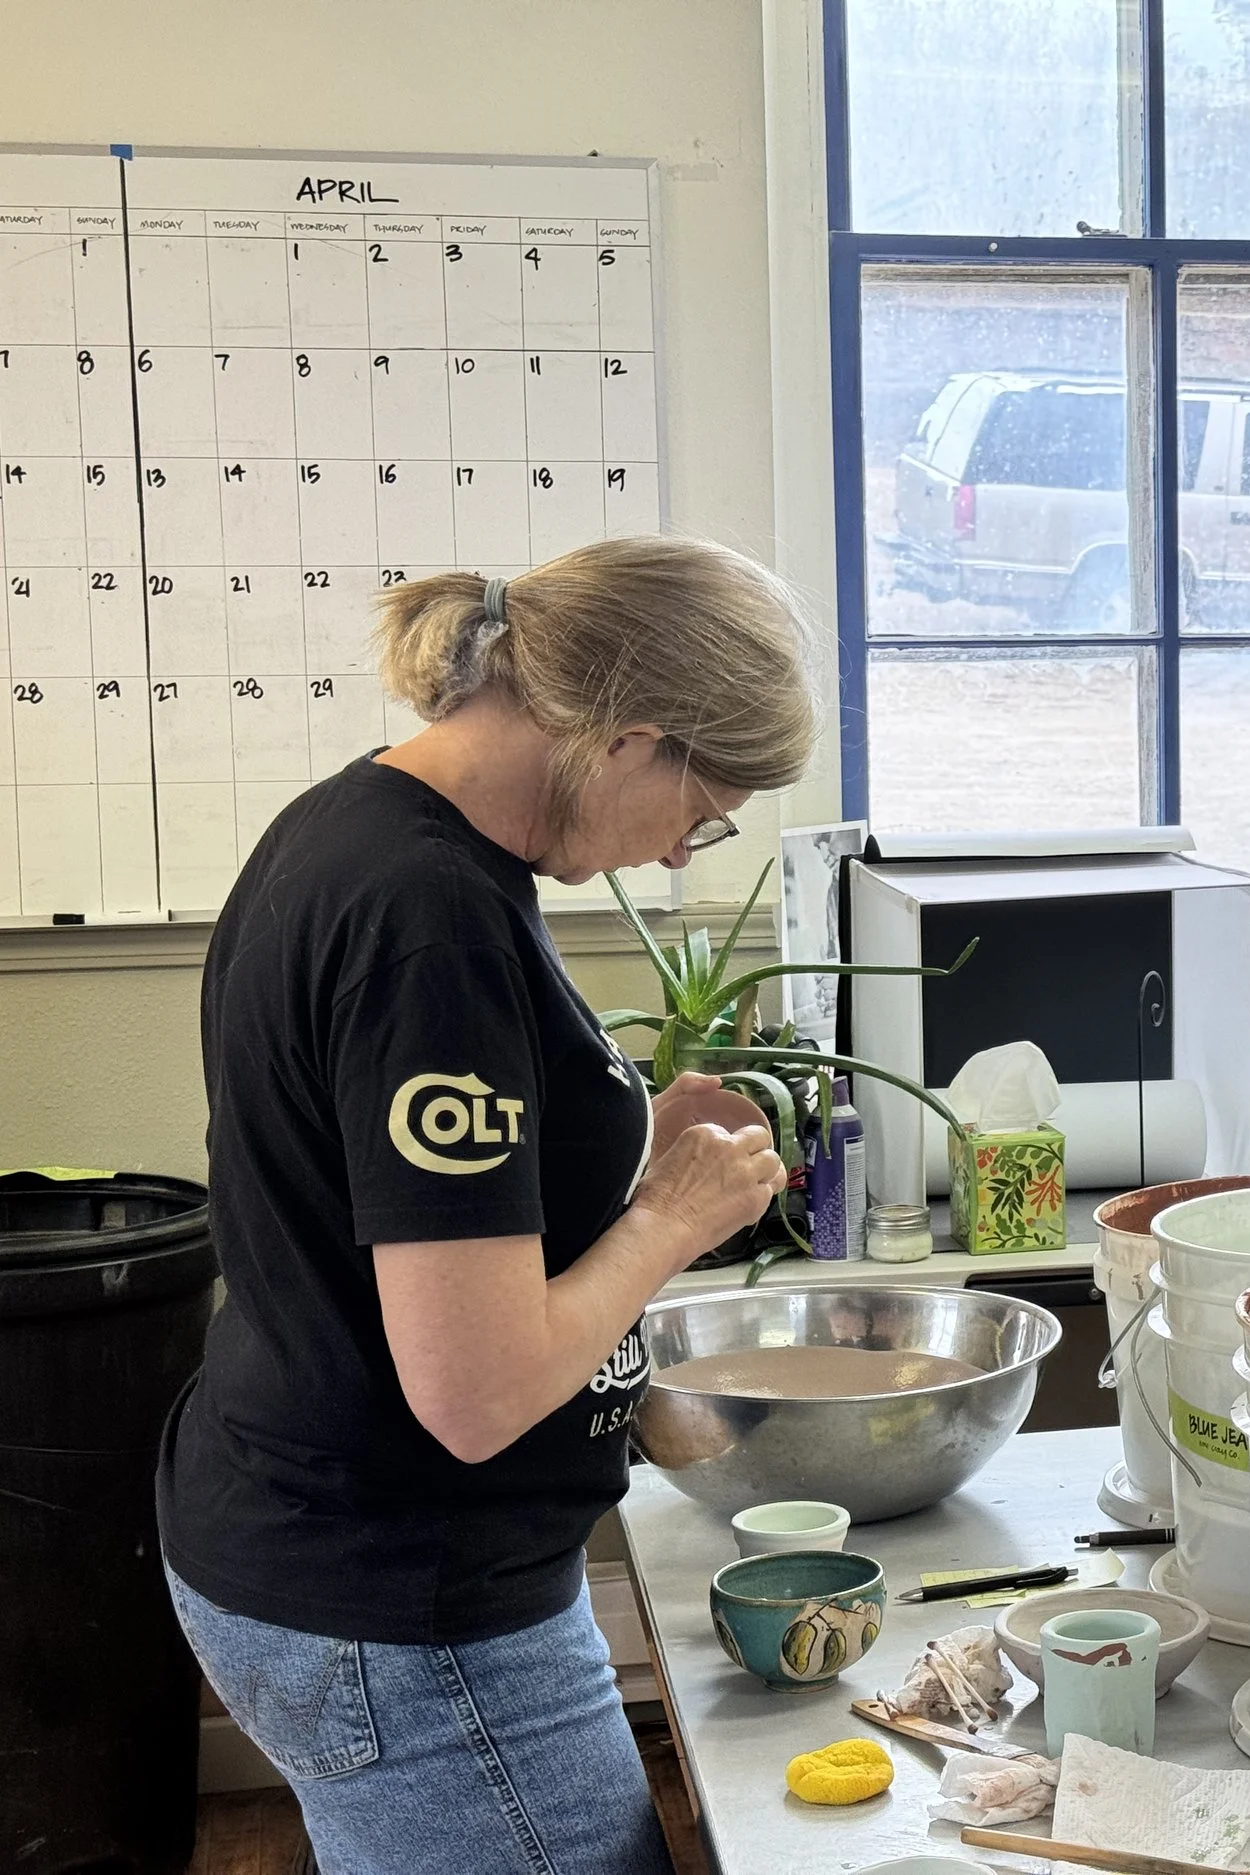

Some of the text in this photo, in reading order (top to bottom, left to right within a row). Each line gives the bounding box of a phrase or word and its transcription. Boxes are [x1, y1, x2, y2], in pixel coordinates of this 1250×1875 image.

[296, 176, 400, 204] APRIL
[76, 216, 116, 230] SUNDAY
[140, 220, 184, 230] MONDAY
[213, 220, 260, 231] TUESDAY
[290, 223, 348, 234] WEDNESDAY
[373, 224, 424, 234] THURSDAY
[450, 225, 487, 236] FRIDAY
[525, 227, 575, 238] SATURDAY
[600, 228, 640, 240] SUNDAY
[368, 244, 389, 262] 2
[445, 244, 464, 262] 3
[524, 247, 542, 270] 4
[598, 250, 616, 266] 5
[76, 350, 95, 374] 8
[137, 349, 153, 373] 6
[214, 354, 230, 371] 7
[296, 354, 312, 378] 8
[374, 356, 390, 375] 9
[454, 357, 475, 374] 10
[530, 356, 541, 376] 11
[604, 358, 628, 378] 12
[6, 464, 27, 484] 14
[86, 464, 106, 486] 15
[146, 468, 166, 488] 13
[224, 464, 246, 482] 14
[300, 464, 321, 484] 15
[378, 464, 397, 484] 16
[456, 467, 474, 486] 17
[532, 468, 554, 490] 18
[607, 468, 626, 492] 19
[91, 573, 118, 591] 22
[149, 575, 174, 596] 20
[230, 575, 251, 594] 21
[304, 571, 331, 588] 22
[13, 682, 44, 704] 28
[96, 680, 121, 700] 29
[154, 682, 178, 702] 27
[232, 678, 264, 699] 28
[310, 678, 334, 699] 29
[388, 1072, 524, 1175] COLT
[1188, 1413, 1218, 1440] BLUE
